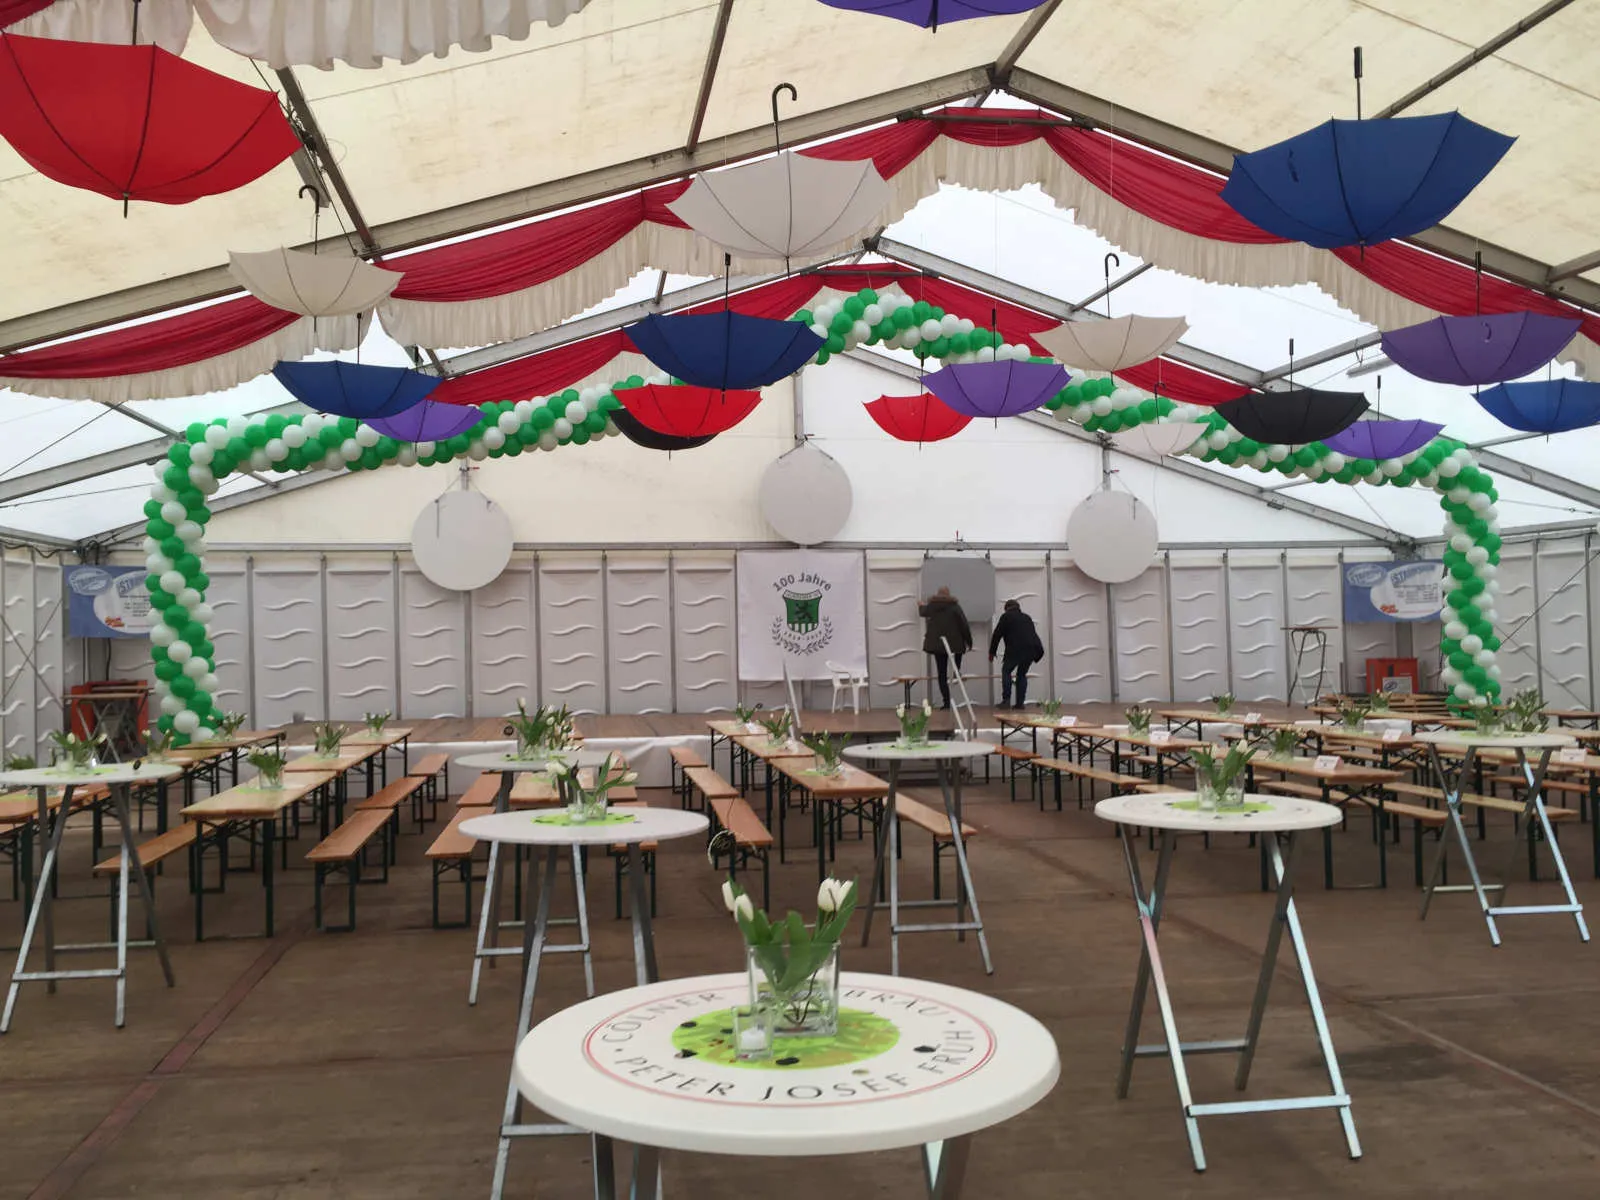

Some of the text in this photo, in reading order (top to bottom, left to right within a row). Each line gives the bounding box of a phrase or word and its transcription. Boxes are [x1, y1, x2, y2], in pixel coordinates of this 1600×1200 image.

[773, 572, 832, 592] 100 Jahre
[615, 1056, 735, 1096] PETER
[761, 1073, 908, 1101] JOSEF
